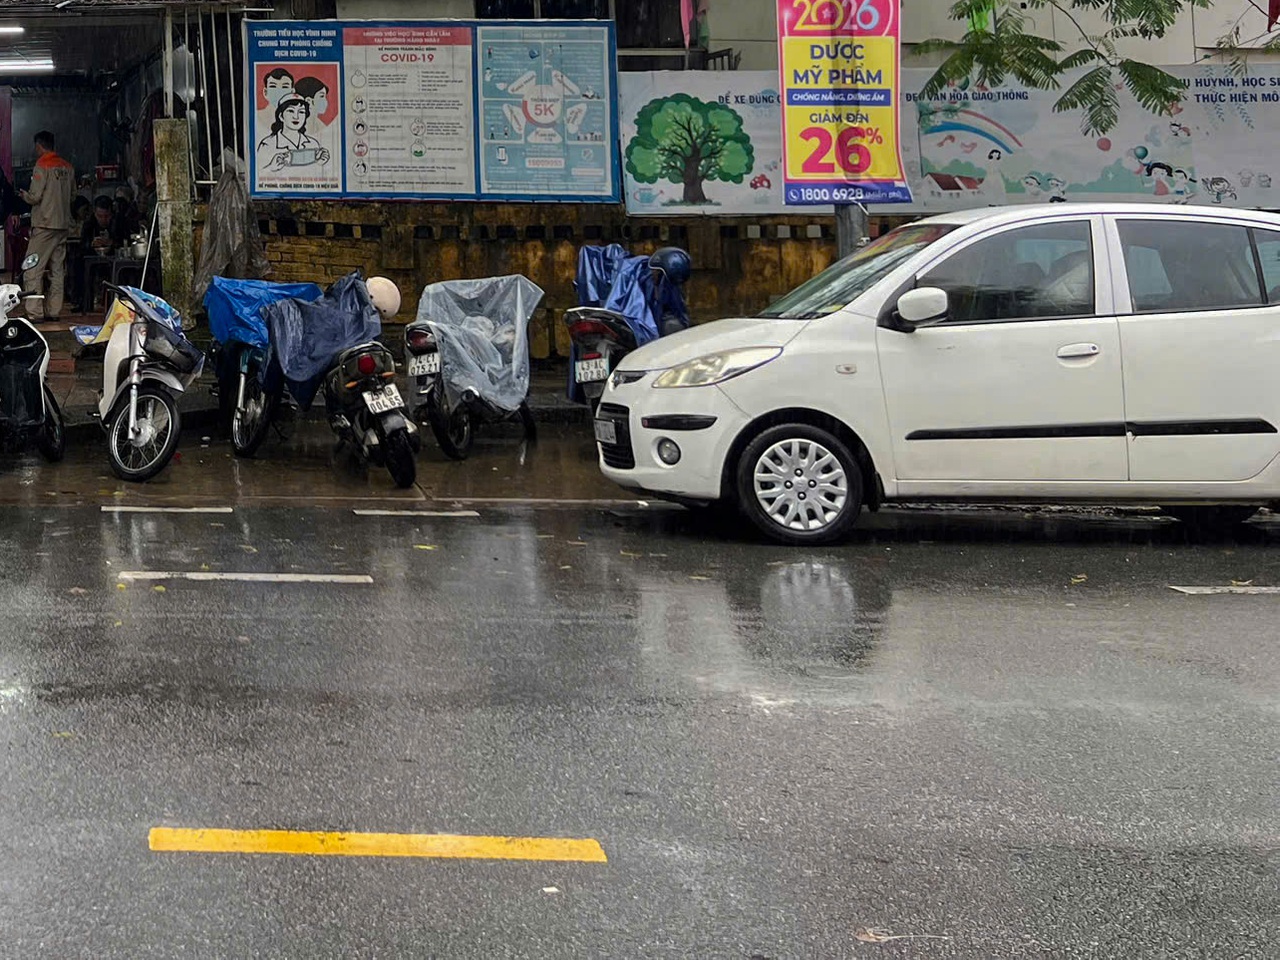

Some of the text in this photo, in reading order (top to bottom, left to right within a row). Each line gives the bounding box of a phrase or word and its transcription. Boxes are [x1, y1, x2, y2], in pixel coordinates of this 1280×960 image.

[381, 53, 434, 62] COVID-19
[810, 41, 865, 63] DƯỢC
[793, 63, 882, 84] MỸ PHẨM
[1195, 78, 1238, 88] HUYNH,
[1242, 78, 1266, 88] HỌC
[734, 95, 745, 104] XE
[972, 91, 993, 101] GIAO
[997, 89, 1028, 100] THÔNG
[1195, 92, 1226, 105] THỰC
[1230, 91, 1258, 104] HIỆN
[535, 104, 554, 116] 5K
[809, 109, 869, 124] GIẢM ĐẾN
[799, 126, 883, 174] 26%
[800, 189, 829, 200] 1800
[832, 188, 864, 200] 6928
